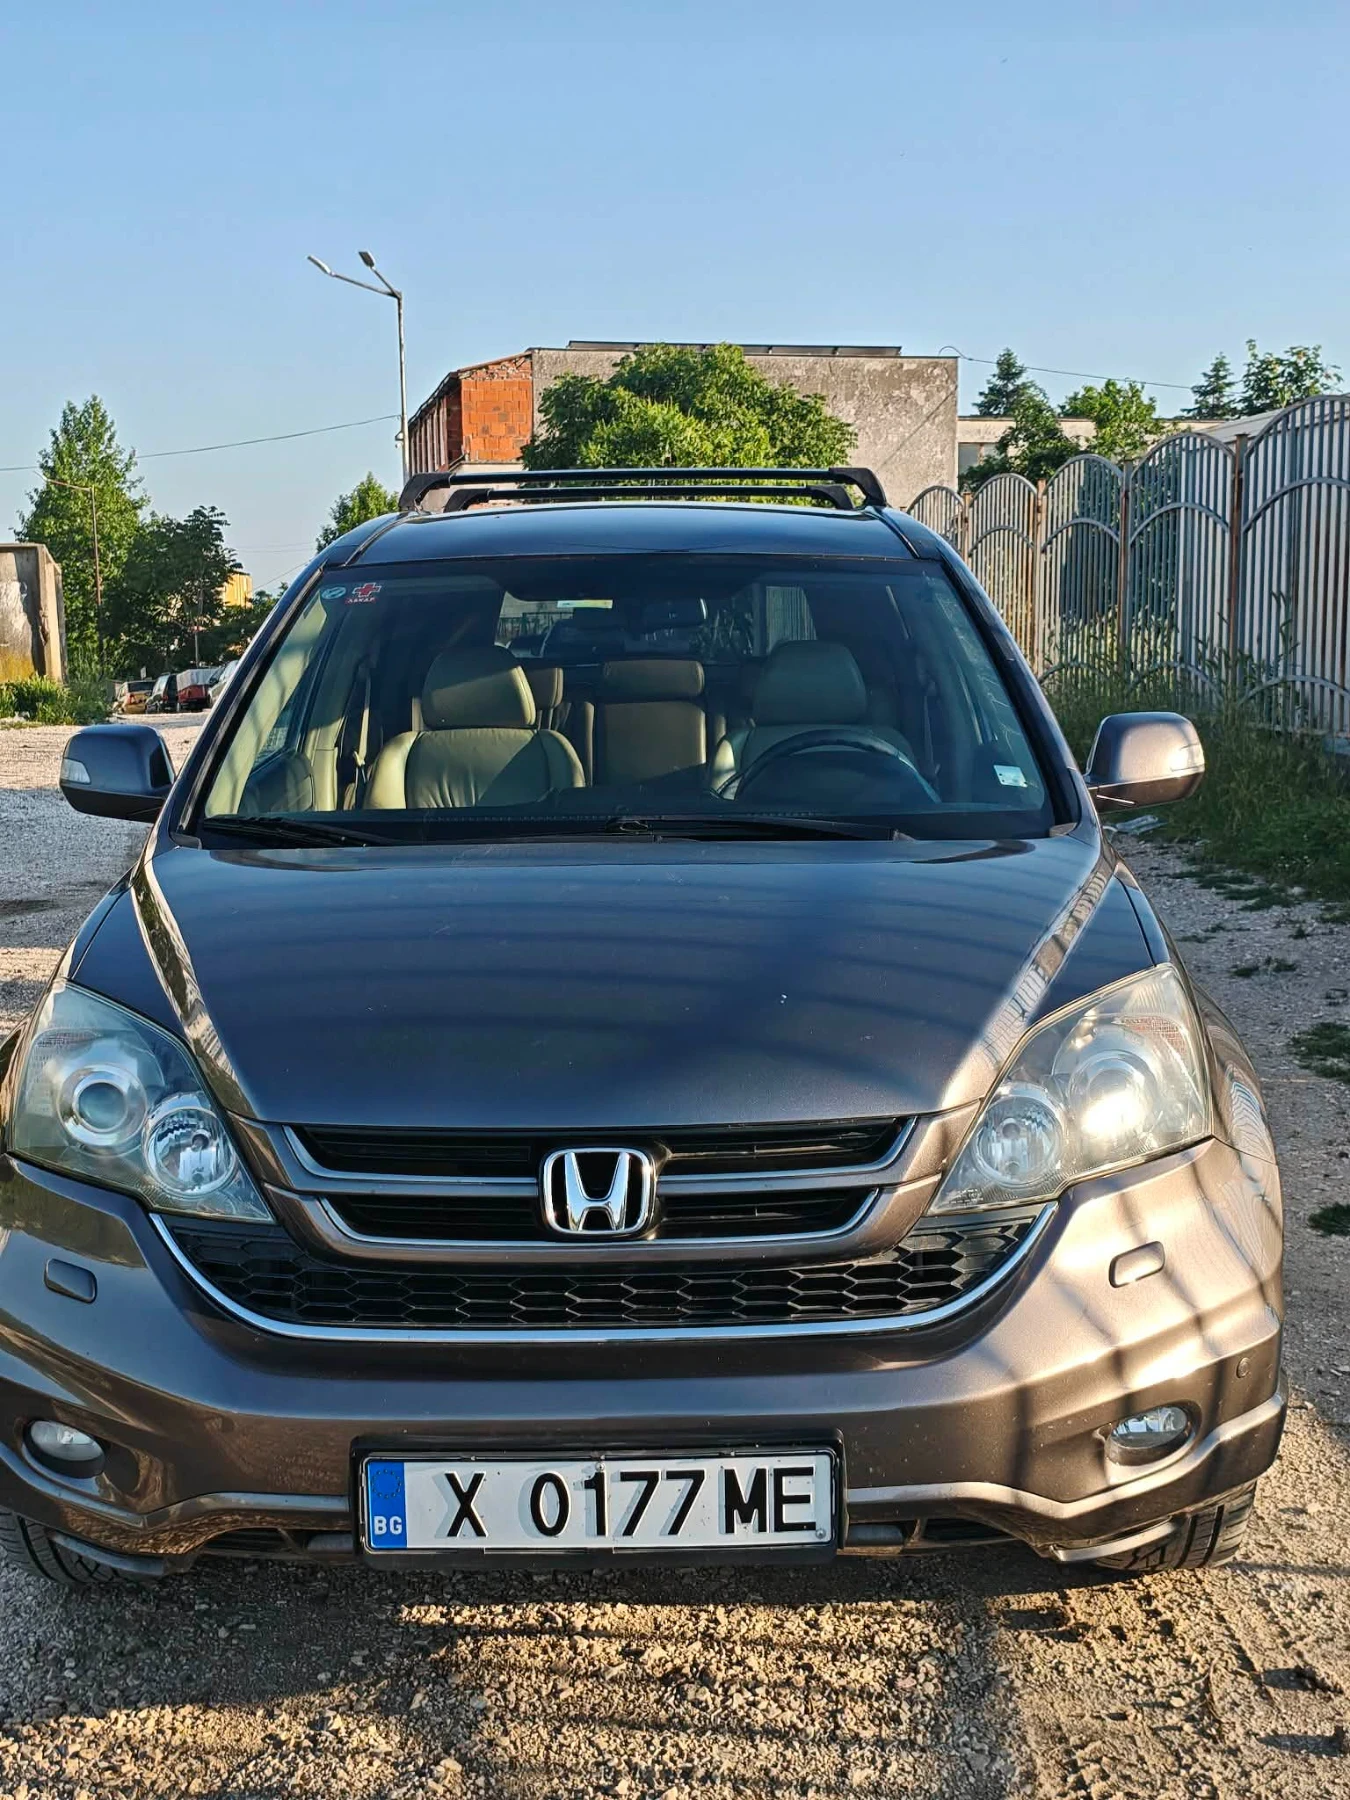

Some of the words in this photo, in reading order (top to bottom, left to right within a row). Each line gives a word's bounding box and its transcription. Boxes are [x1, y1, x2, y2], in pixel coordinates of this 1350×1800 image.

[445, 1472, 487, 1537] X
[530, 1470, 706, 1537] 0177
[724, 1466, 817, 1534] ME
[374, 1516, 402, 1535] BG
